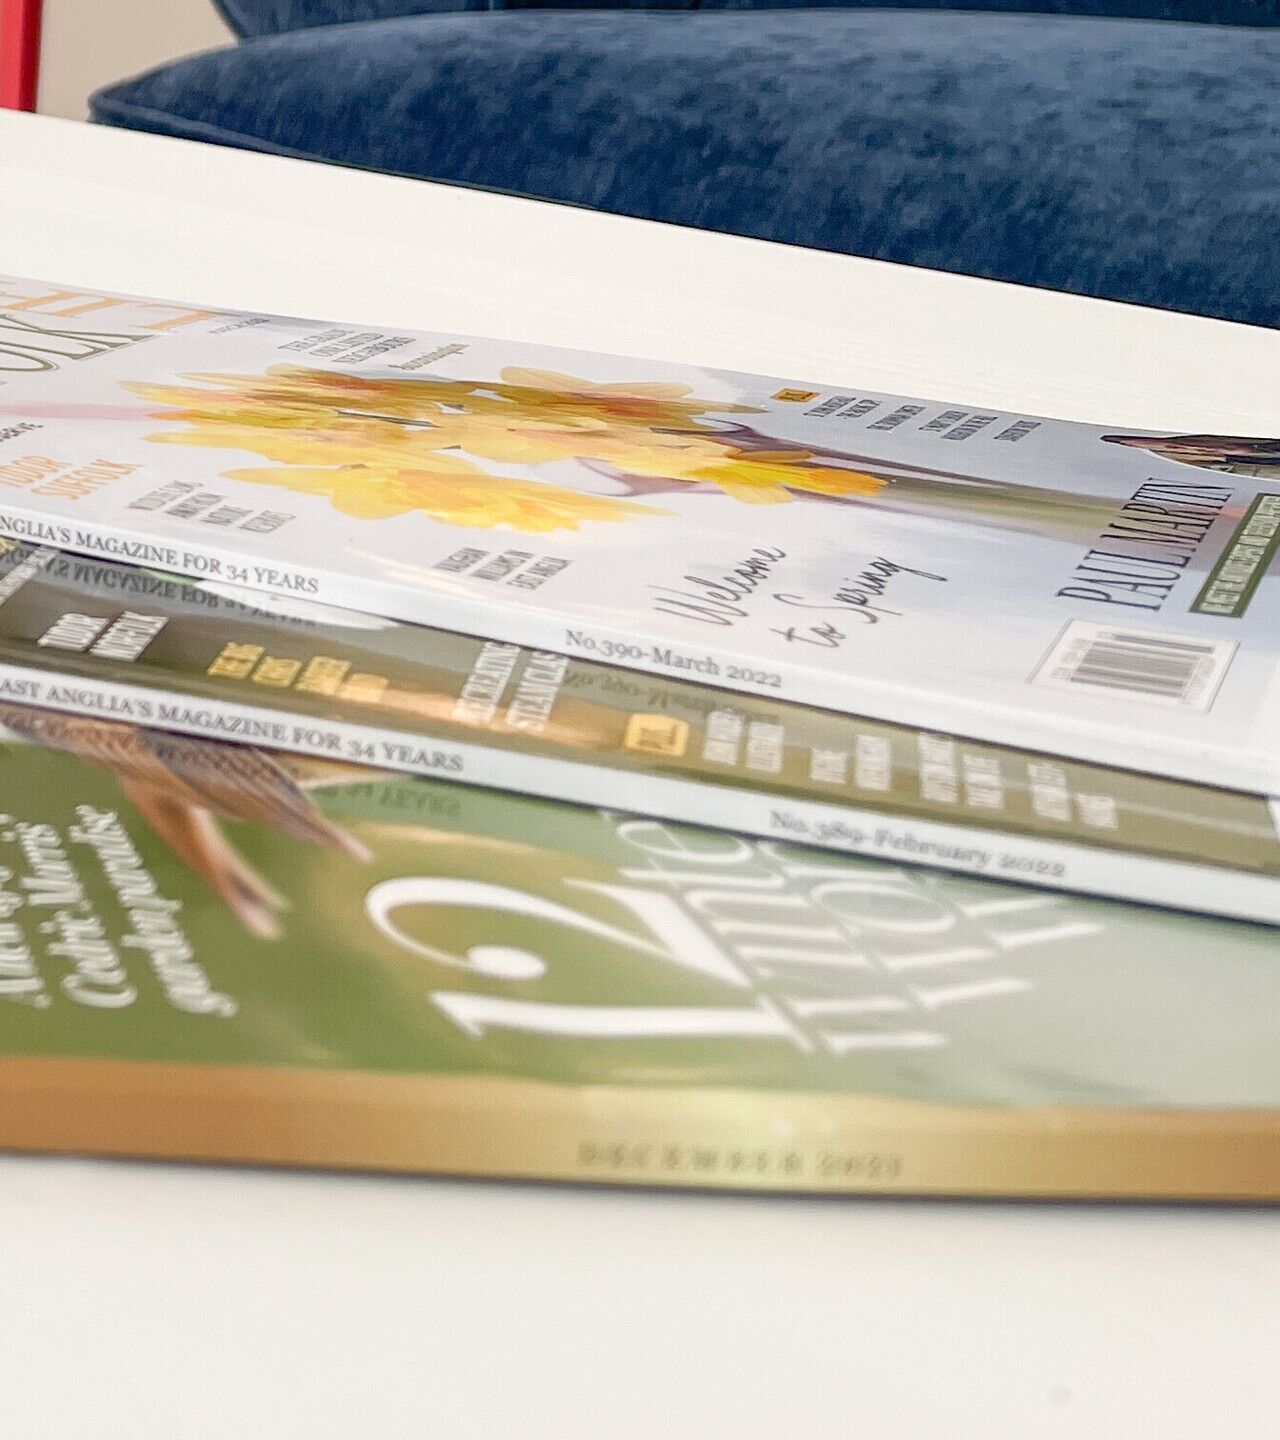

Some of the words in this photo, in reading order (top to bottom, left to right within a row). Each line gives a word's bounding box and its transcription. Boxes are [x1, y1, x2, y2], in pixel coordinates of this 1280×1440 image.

[30, 459, 143, 500] SUFFOLK
[1099, 477, 1236, 553] MARTIN
[75, 531, 178, 566] MAGAZINE
[183, 553, 221, 576] FOR
[226, 564, 248, 581] 34
[253, 566, 319, 594] YEARS
[645, 546, 788, 626] Welcome
[773, 556, 947, 624] Spring
[1055, 548, 1190, 612] PAUL
[37, 613, 110, 653] TUDOR
[89, 610, 171, 662] NORFOLK
[770, 622, 846, 648] to
[726, 664, 783, 689] 2022
[45, 685, 153, 719] ANGLIA'S
[158, 706, 287, 742] MAGAZINE
[293, 728, 341, 751] FOR
[347, 740, 377, 758] 34
[382, 743, 463, 773] YEARS
[70, 803, 182, 920] paradise
[999, 851, 1066, 878] 2022
[40, 910, 139, 1010] Cedric
[123, 918, 238, 1018] garden
[365, 875, 822, 1055] 12
